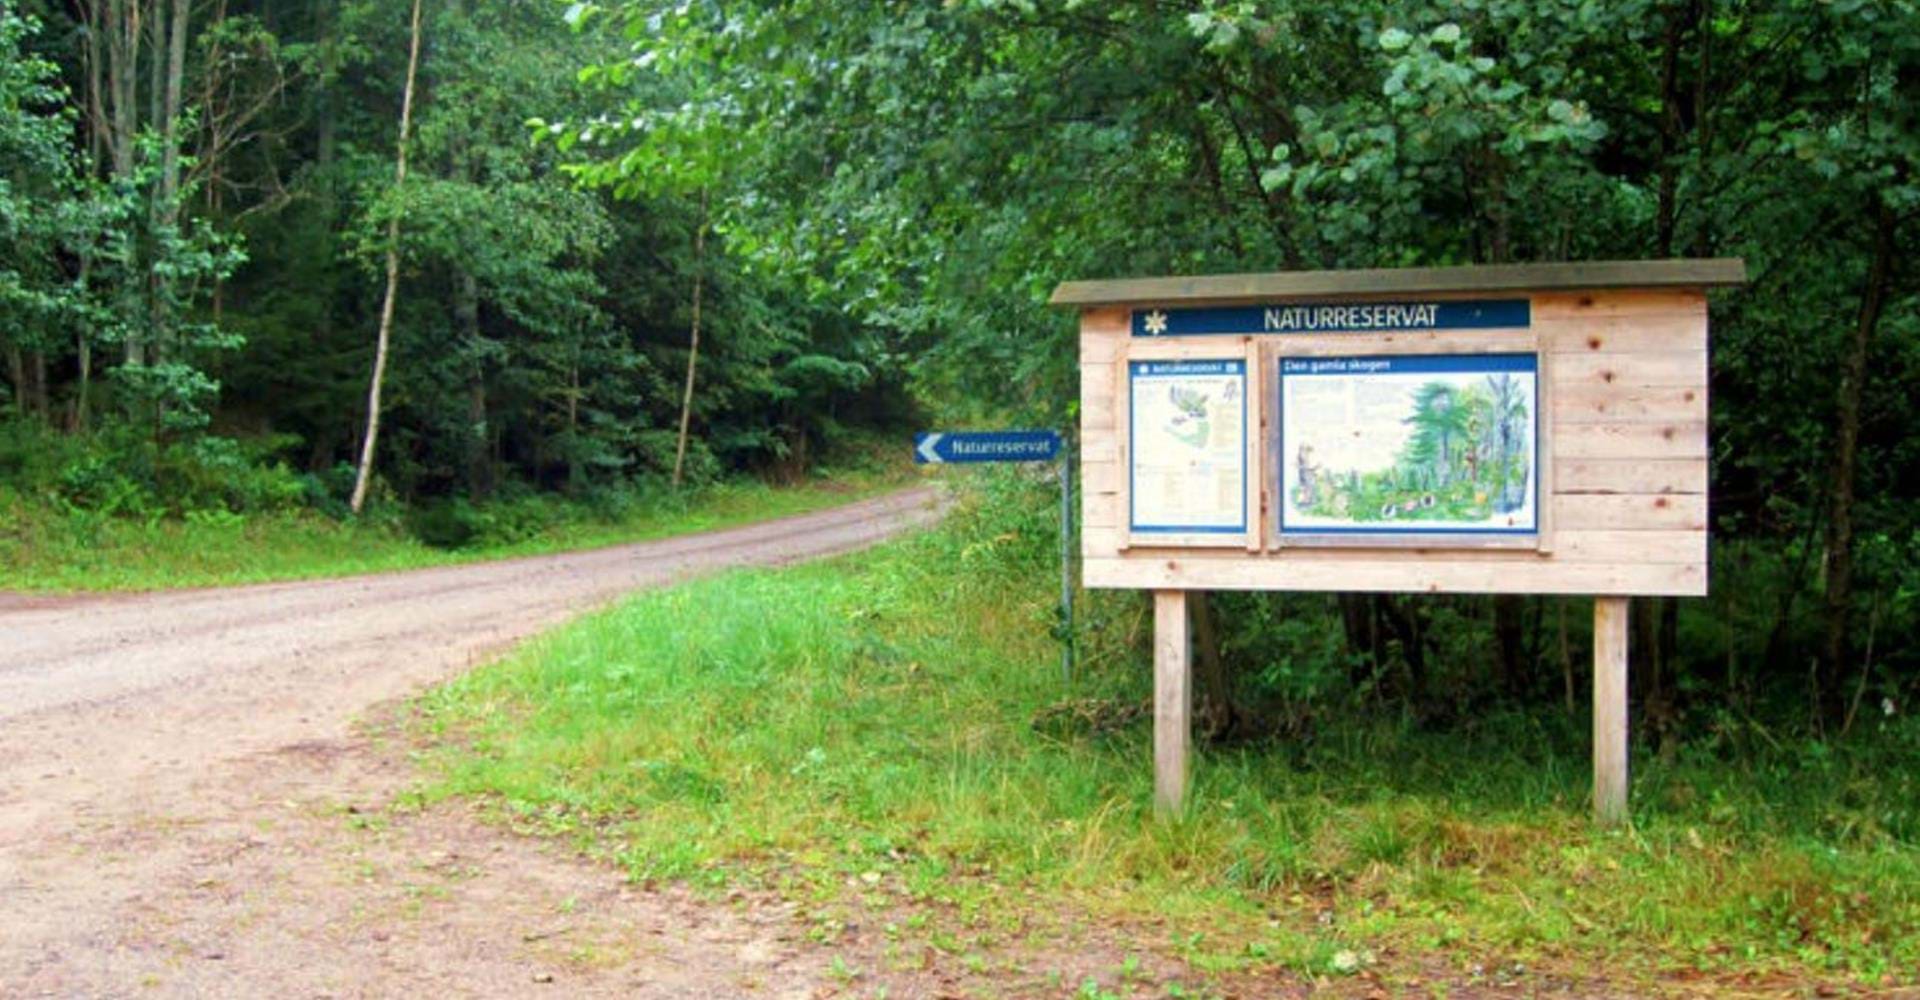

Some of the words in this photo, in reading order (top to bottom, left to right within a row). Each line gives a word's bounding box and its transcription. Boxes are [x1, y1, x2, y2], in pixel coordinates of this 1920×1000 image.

[1264, 304, 1439, 330] NATURRESERVAT
[1284, 360, 1307, 371] Den
[1348, 360, 1391, 373] skogen
[953, 440, 1050, 454] Naturreservat
